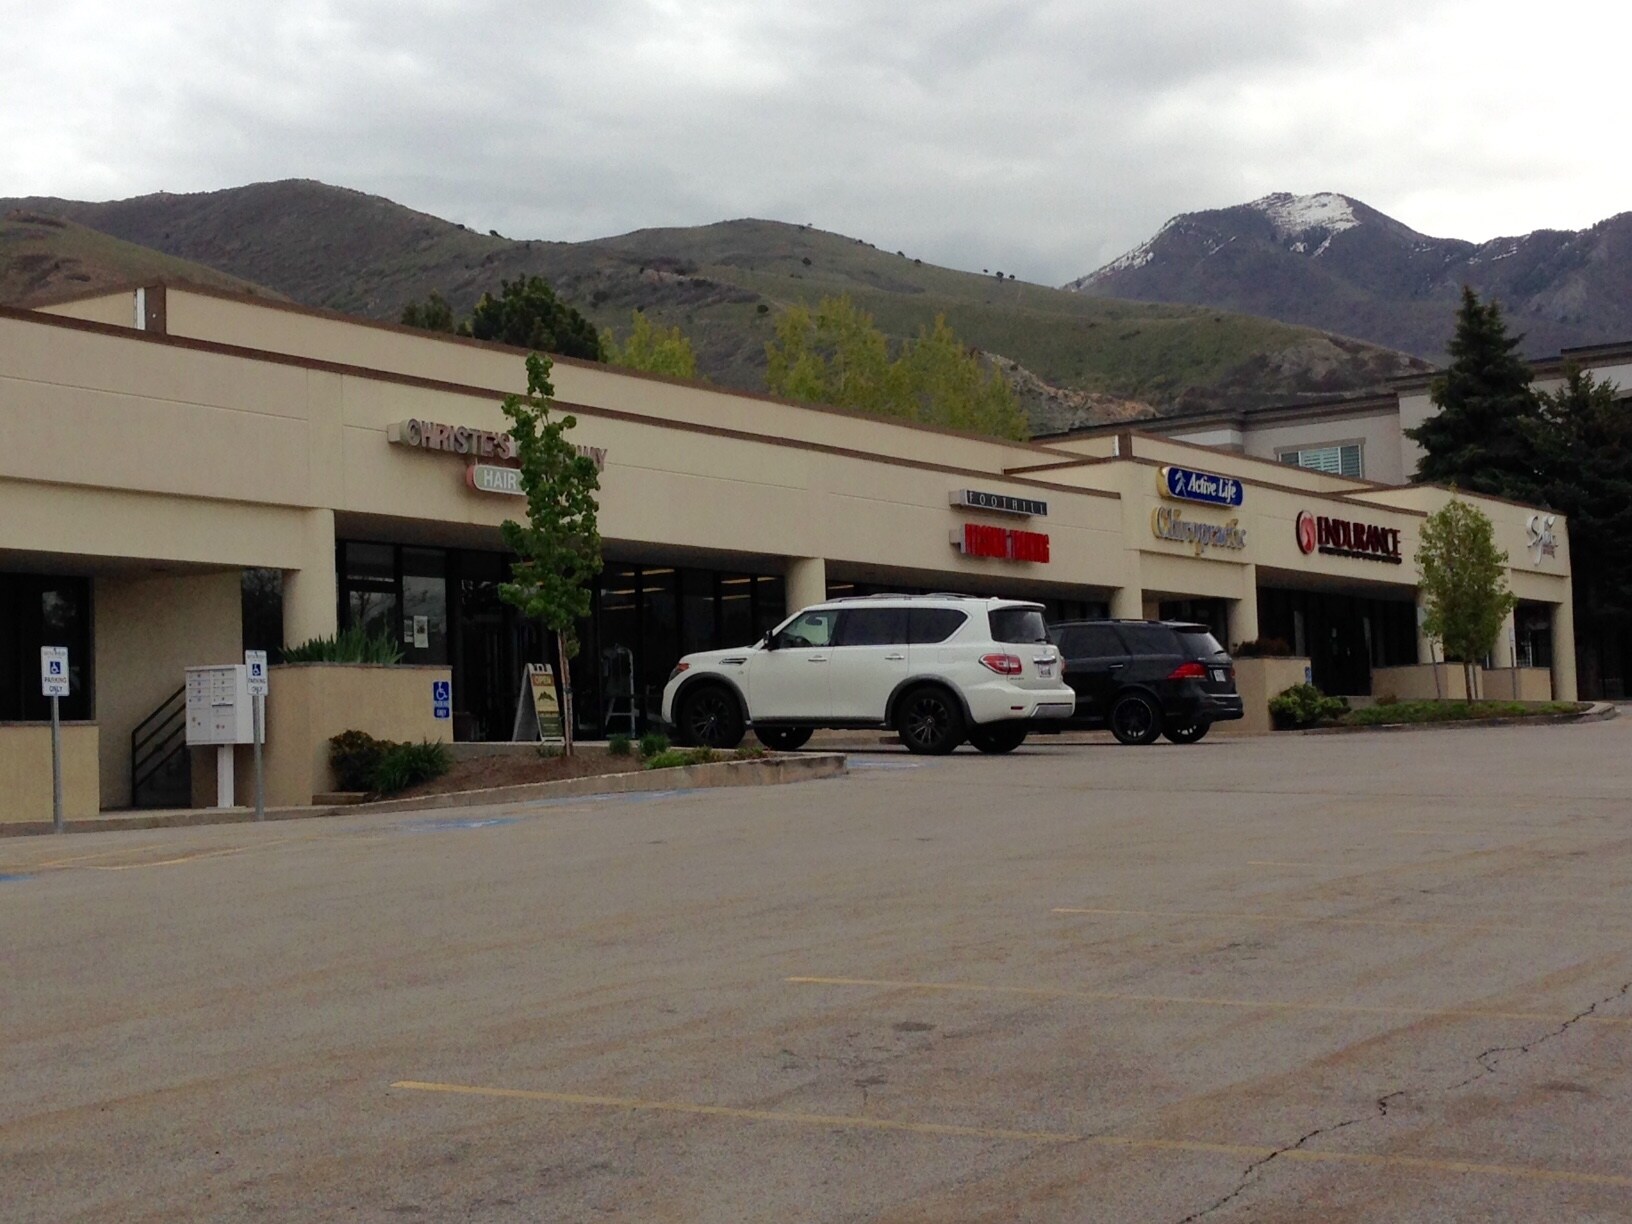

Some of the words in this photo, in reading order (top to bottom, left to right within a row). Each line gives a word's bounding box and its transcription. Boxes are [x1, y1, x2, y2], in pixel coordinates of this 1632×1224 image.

[483, 469, 518, 489] HAIR
[1187, 473, 1217, 496] Active
[1218, 478, 1237, 504] Life
[968, 491, 1044, 515] FOOTHILL
[1316, 516, 1402, 557] ENDURANCE
[44, 676, 67, 684] PARKING
